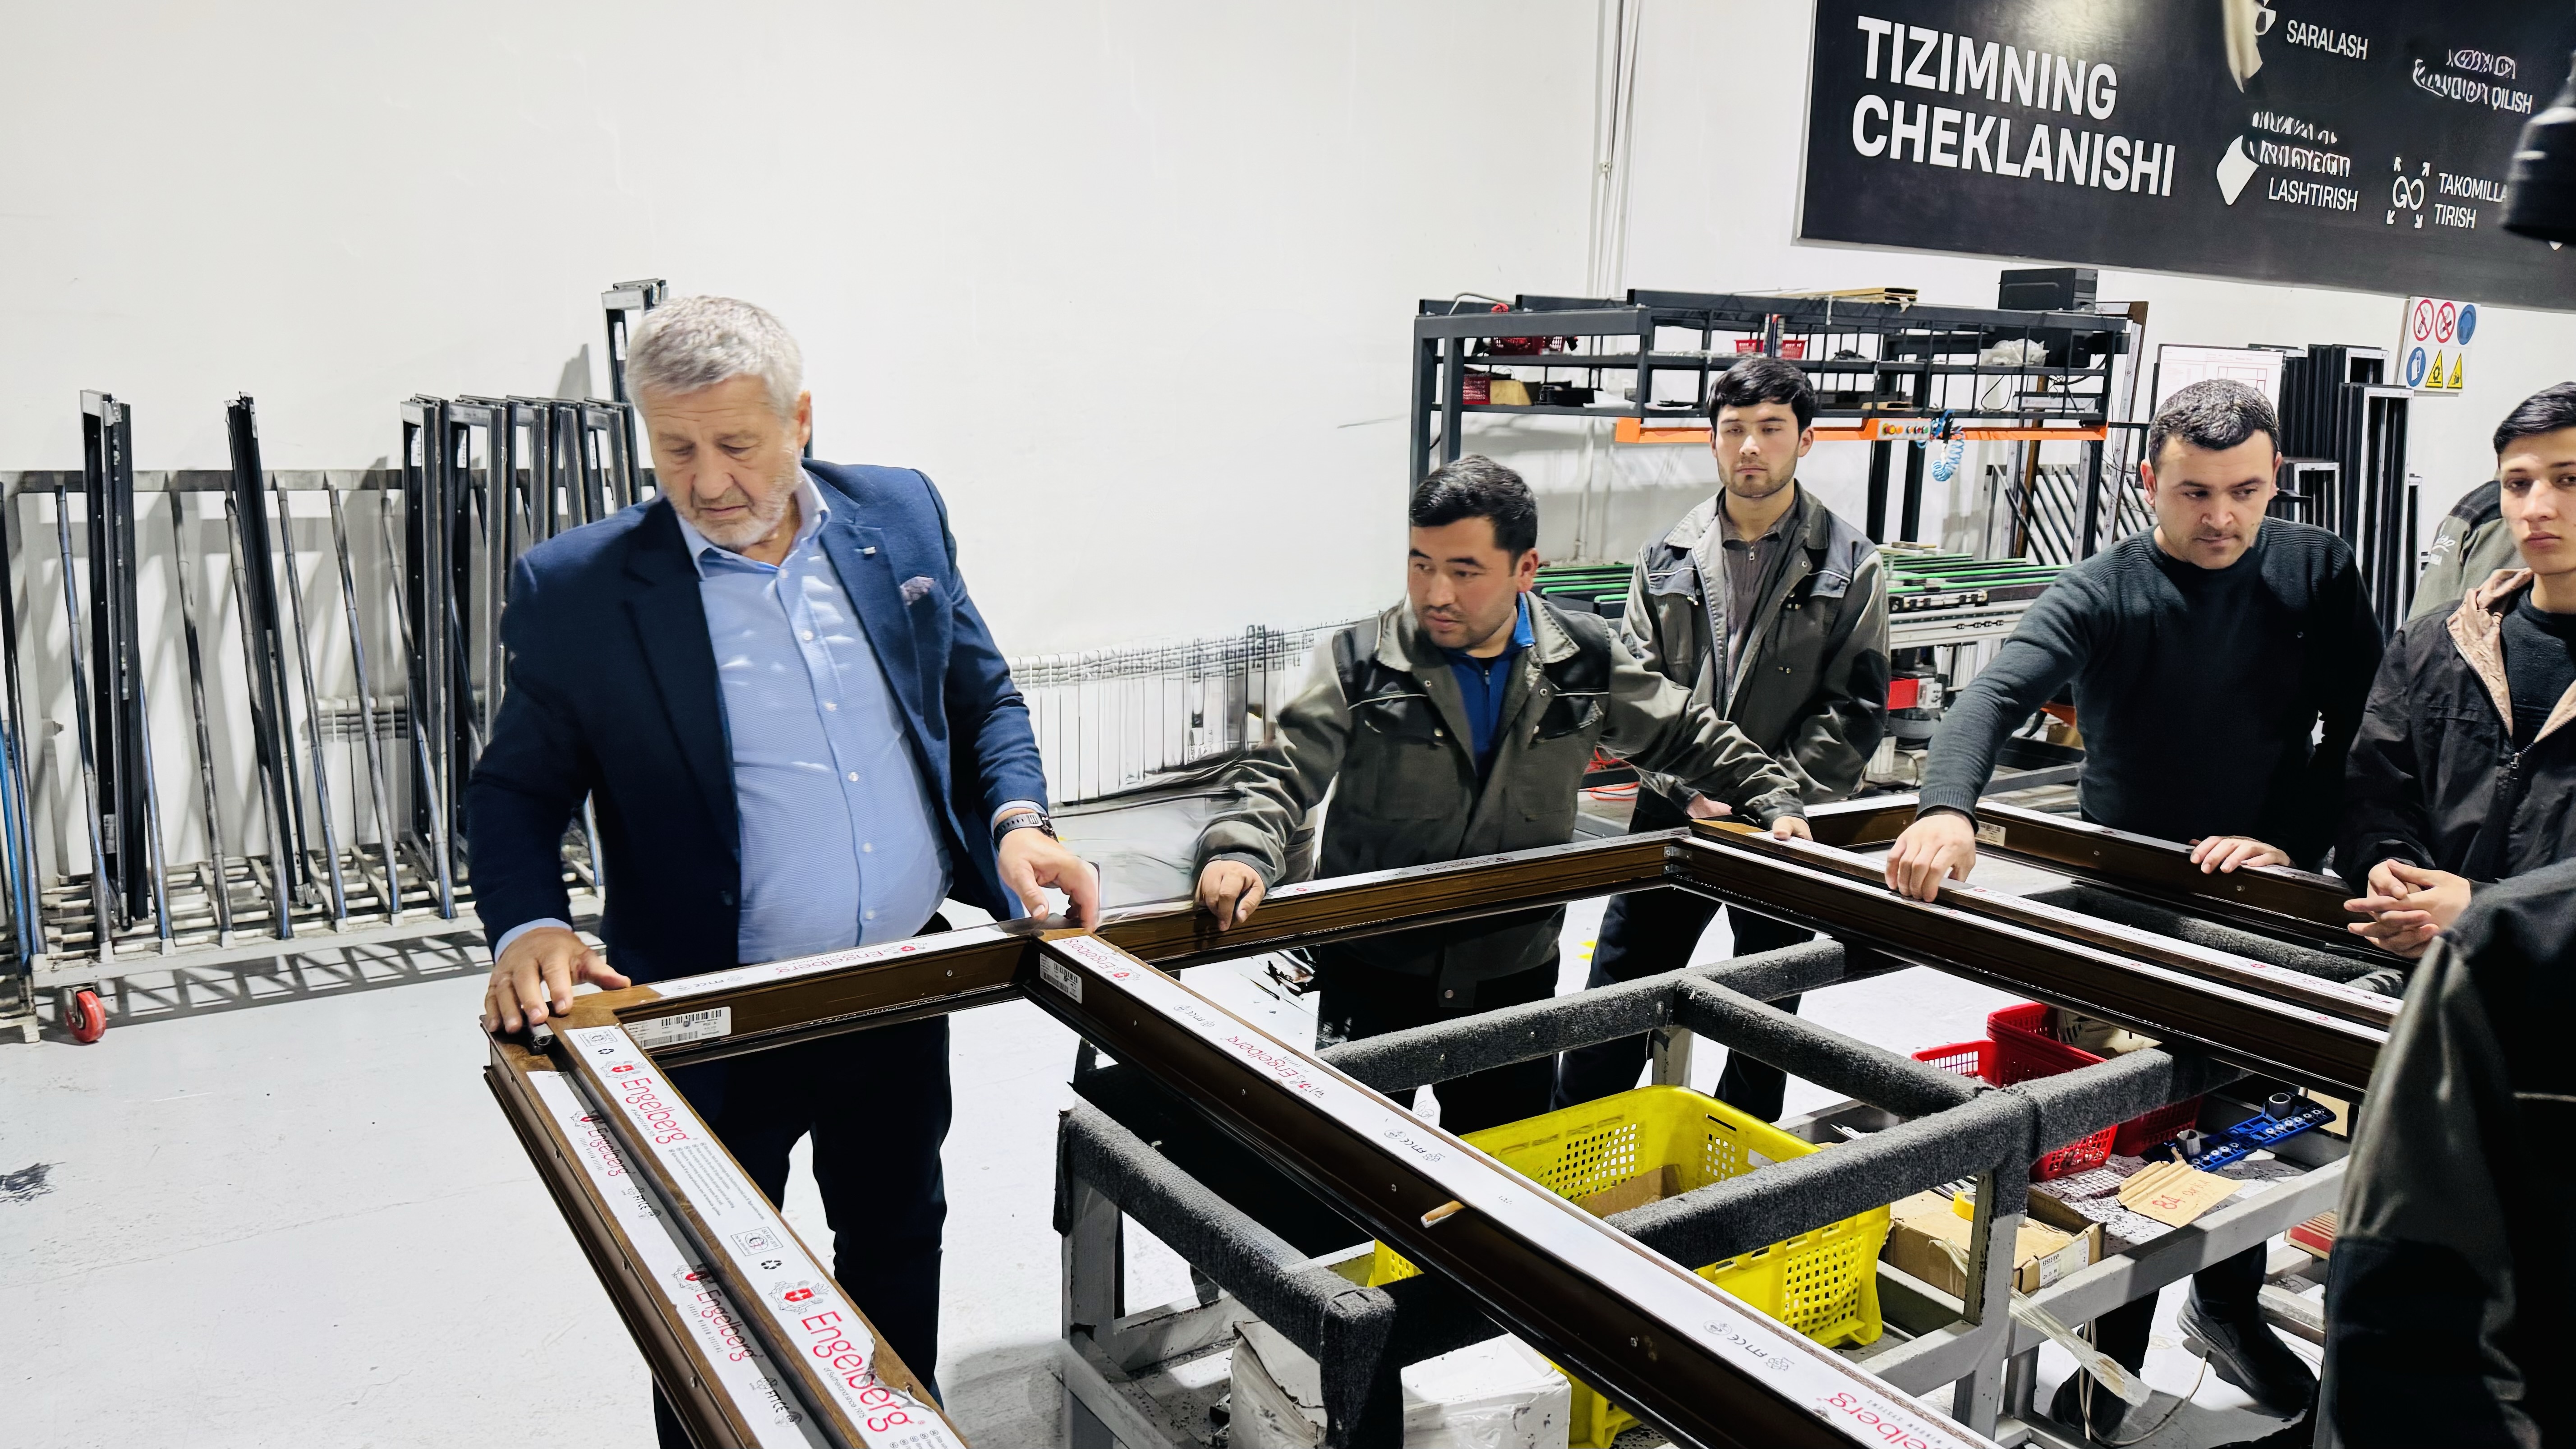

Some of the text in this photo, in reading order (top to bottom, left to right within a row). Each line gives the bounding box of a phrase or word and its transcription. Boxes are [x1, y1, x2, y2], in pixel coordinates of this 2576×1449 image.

[1857, 15, 2117, 120] TIZIMNING
[2286, 20, 2368, 60] SARALASH
[1852, 94, 2176, 196] CHEKLANISHI
[2268, 177, 2358, 212] LASHTIRISH
[2435, 203, 2476, 229] TIRISH
[621, 1077, 691, 1144] Engelberg
[588, 1128, 631, 1177] Engelberg
[696, 1290, 758, 1362] Engelberg
[801, 1311, 915, 1432] Engelberg
[1824, 1392, 1933, 1449] elberg
